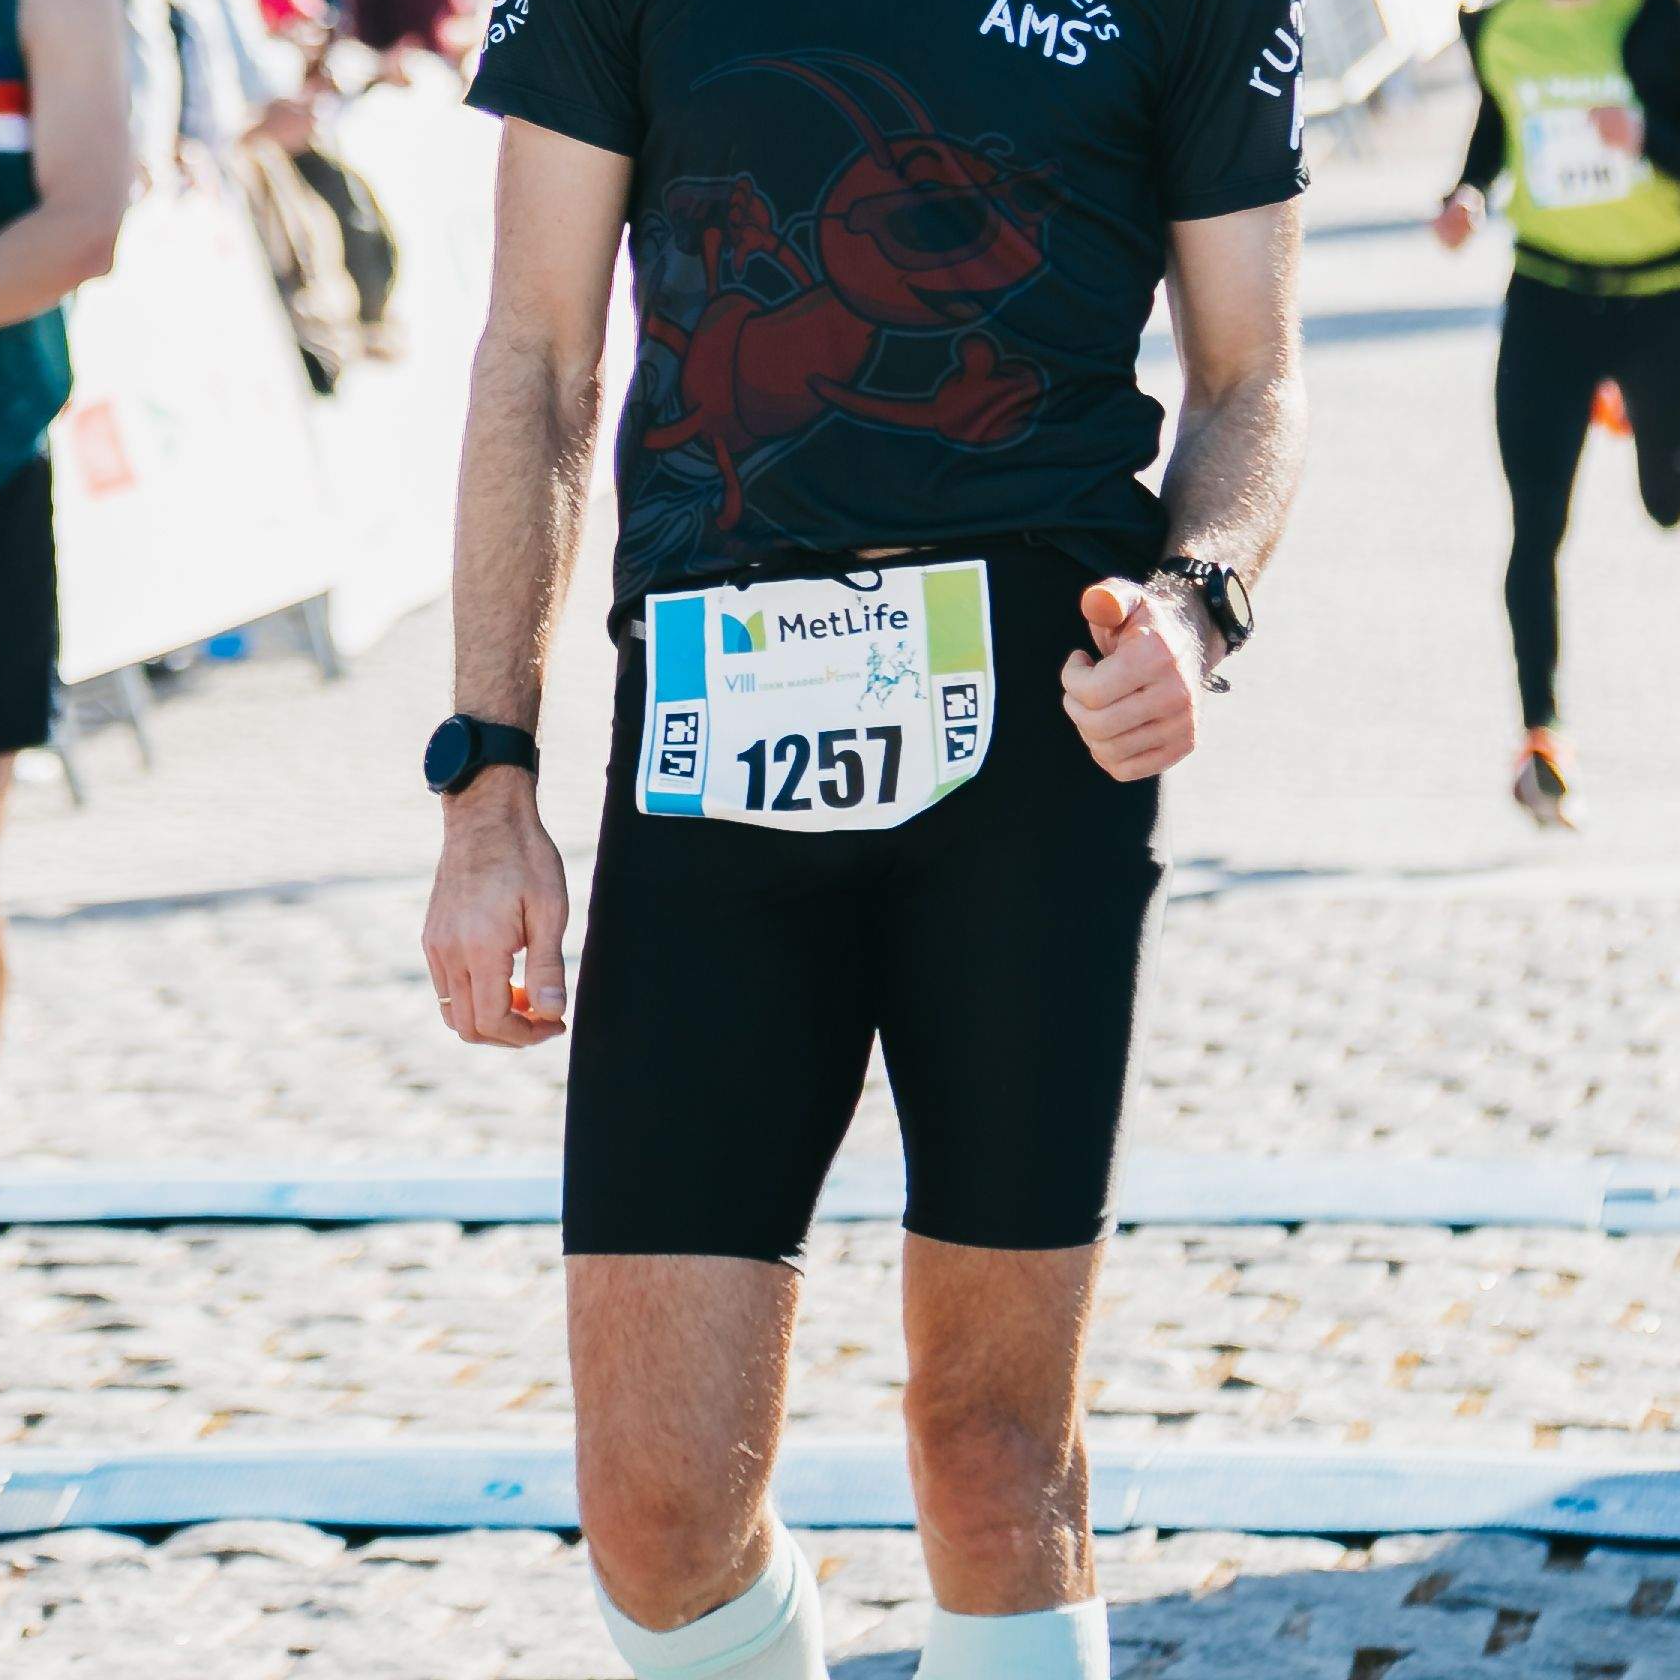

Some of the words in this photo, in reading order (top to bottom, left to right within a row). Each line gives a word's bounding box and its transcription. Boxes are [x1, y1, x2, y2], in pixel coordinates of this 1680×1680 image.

[778, 602, 910, 643] MetLife
[723, 672, 756, 694] VIII
[736, 725, 902, 811] 1257
